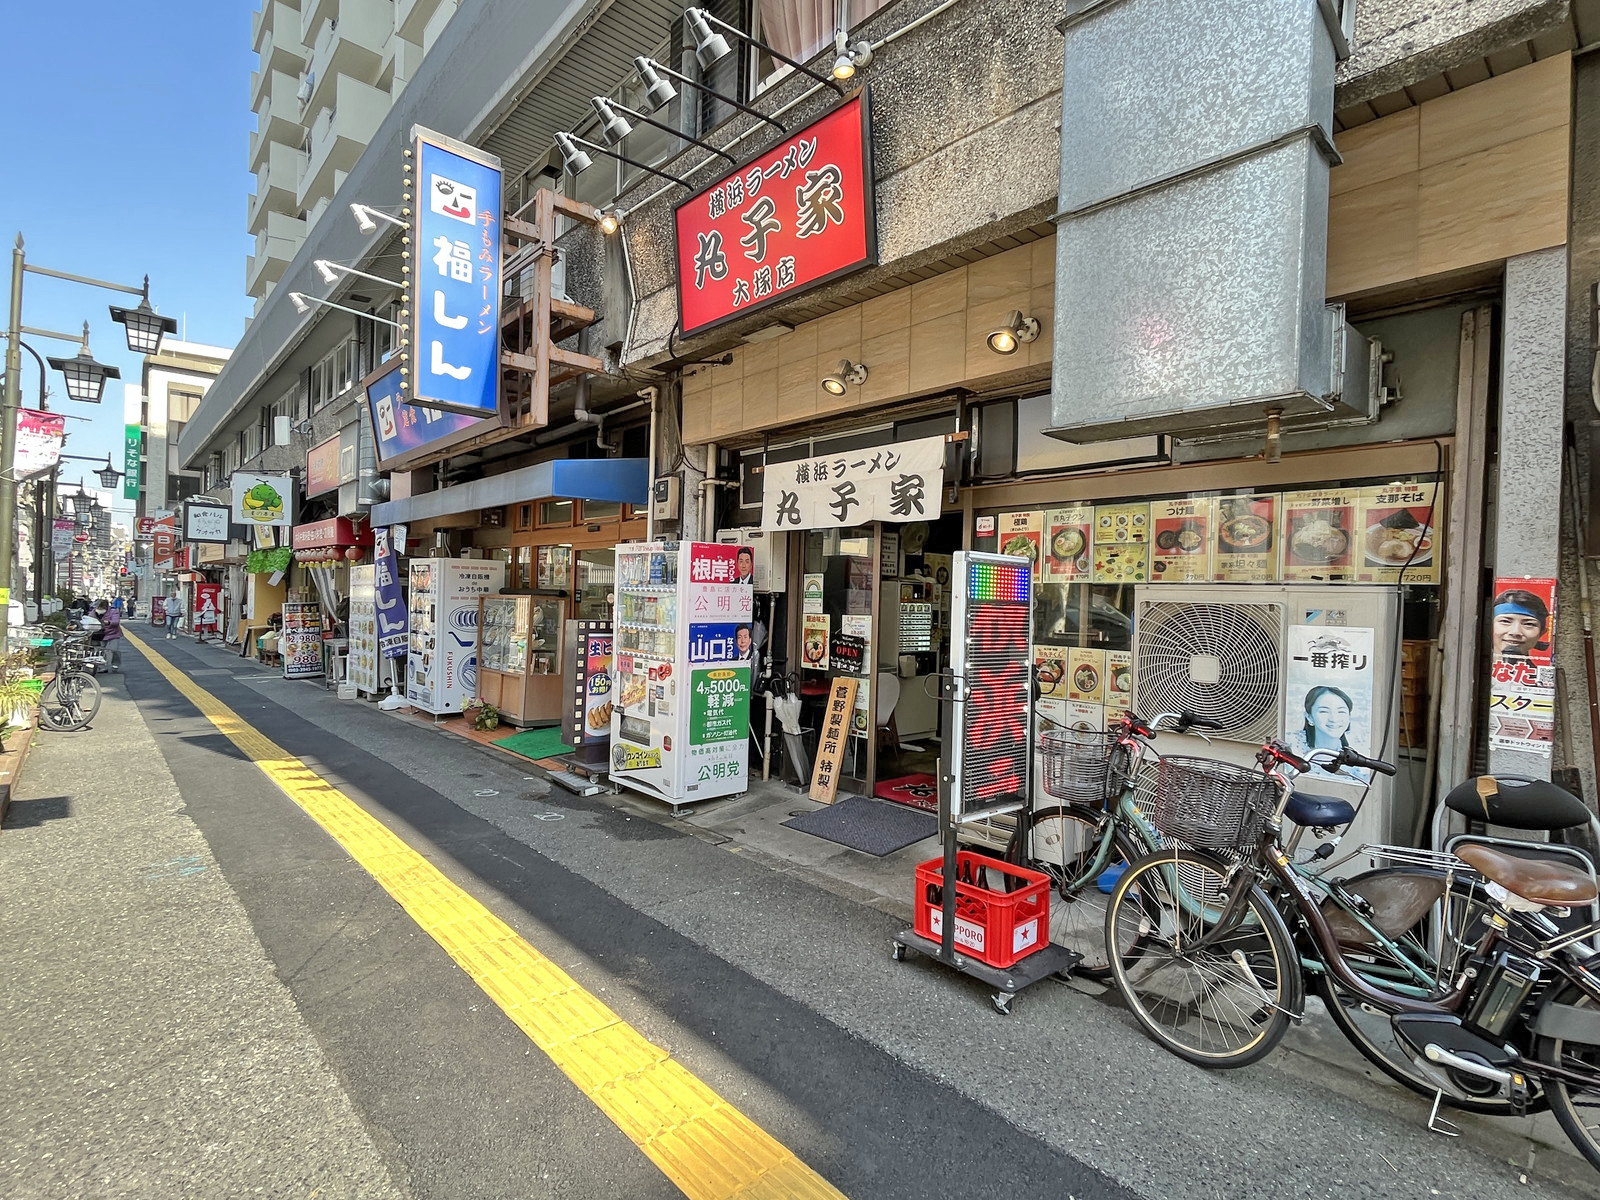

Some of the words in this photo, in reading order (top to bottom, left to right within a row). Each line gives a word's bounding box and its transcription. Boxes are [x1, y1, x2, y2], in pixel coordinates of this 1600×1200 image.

[708, 136, 818, 220] 横浜ラーメン
[694, 163, 844, 291] 丸子家
[477, 209, 496, 335] 手もみラーメン
[732, 255, 796, 308] 大塚店
[429, 235, 474, 381] 福しん
[126, 438, 138, 488] りそな銀行
[795, 449, 902, 485] 横浜ラーメン
[775, 473, 925, 527] 丸子家
[1375, 492, 1425, 504] 支那そば
[692, 557, 729, 582] 根岸
[728, 558, 736, 582] みつひろ
[1403, 574, 1432, 582] 720円
[694, 595, 752, 612] 公明党
[691, 638, 726, 661] 山口
[836, 646, 862, 658] OPEN
[1293, 652, 1367, 671] 一番搾り
[706, 708, 724, 717] 電気代
[707, 693, 735, 709] 軽減
[697, 760, 740, 782] 公明党
